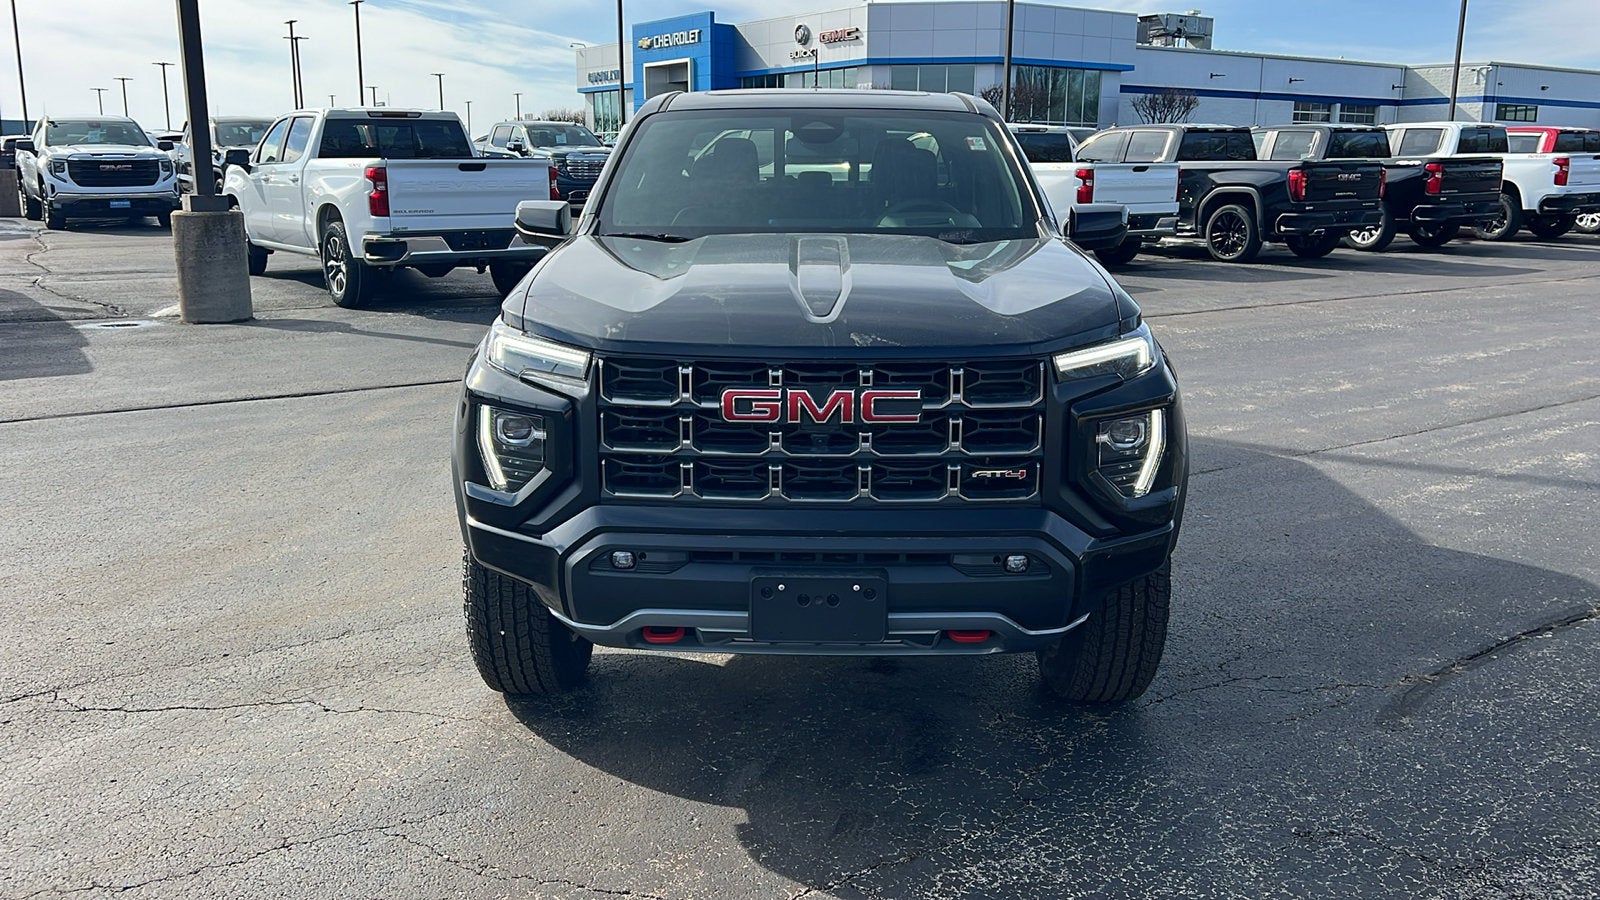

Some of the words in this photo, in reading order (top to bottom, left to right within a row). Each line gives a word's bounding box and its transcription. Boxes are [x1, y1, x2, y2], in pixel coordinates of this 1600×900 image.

[653, 29, 701, 49] CHEVROLET
[819, 27, 860, 44] GMC
[789, 48, 817, 60] BUICK
[1337, 173, 1362, 181] GMC
[720, 388, 922, 424] GMC
[971, 469, 1027, 480] AT4
